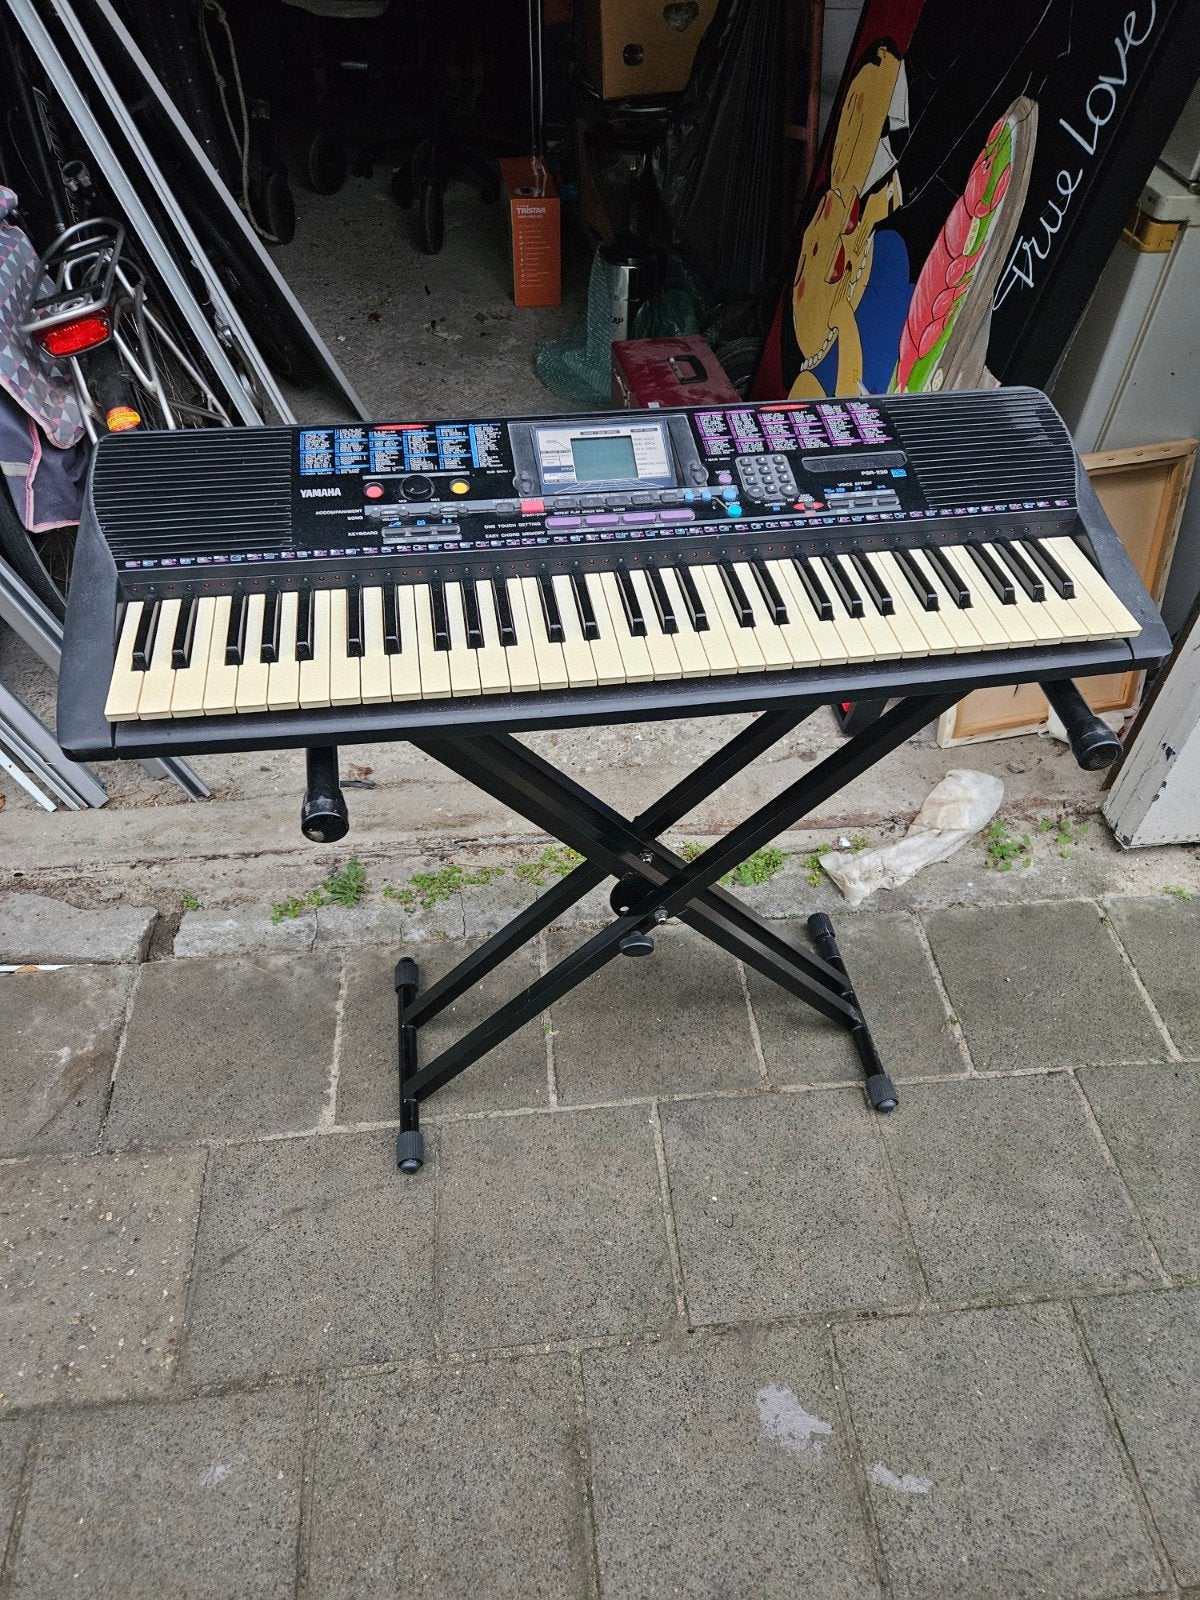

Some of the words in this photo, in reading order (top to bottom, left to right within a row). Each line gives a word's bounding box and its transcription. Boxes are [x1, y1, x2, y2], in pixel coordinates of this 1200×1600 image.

[516, 206, 546, 214] TRISTAR
[300, 487, 341, 498] YAMAHA
[315, 508, 363, 516] ACCOMPANIMENT
